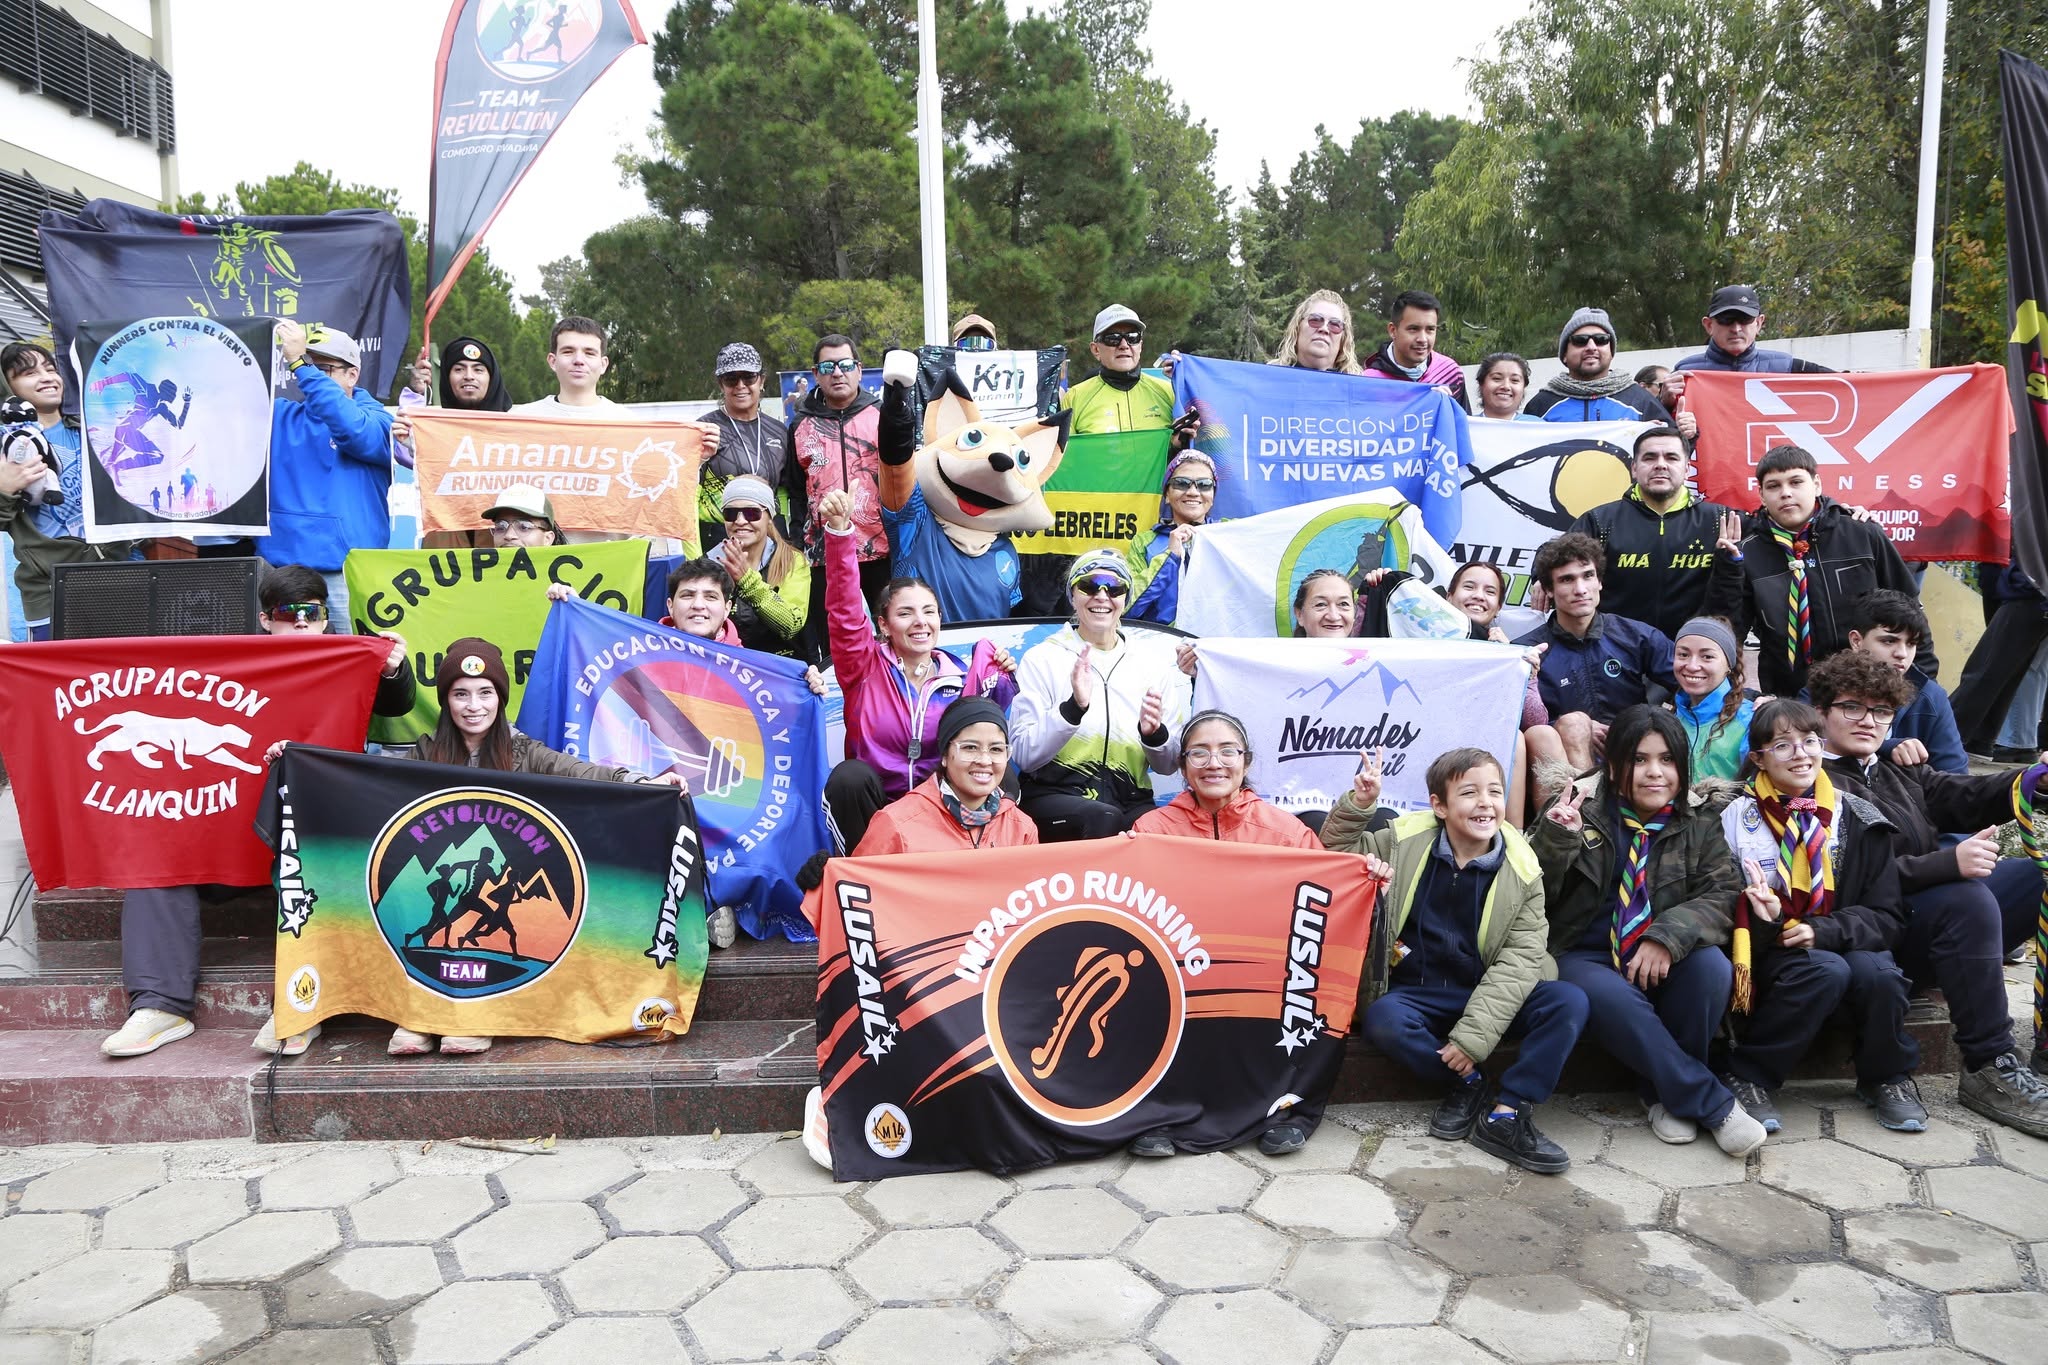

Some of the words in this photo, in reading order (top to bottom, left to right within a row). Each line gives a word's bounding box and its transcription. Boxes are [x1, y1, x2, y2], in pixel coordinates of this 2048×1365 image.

[479, 90, 541, 108] TEAM
[441, 145, 494, 158] COMODORO
[99, 325, 147, 366] RUNNERS
[149, 319, 200, 332] CONTRA
[203, 325, 216, 337] EL
[217, 331, 253, 367] VIENTO
[1261, 416, 1396, 436] DIRECCIÓN
[1403, 409, 1434, 433] DE
[450, 435, 618, 470] Amanus
[1260, 436, 1416, 458] DIVERSIDAD
[451, 474, 545, 492] RUNNING
[548, 475, 600, 492] CLUB
[1258, 463, 1276, 482] Y
[1283, 462, 1387, 483] NUEVAS
[1747, 473, 1957, 492] FNESS
[1447, 543, 1537, 568] ATLE
[355, 547, 628, 636] AGRUPACIO
[54, 667, 271, 721] AGRUPACION
[772, 728, 791, 744] Y
[1278, 712, 1422, 752] Nómades
[83, 776, 238, 821] LLANQUIN
[736, 755, 792, 853] DEPORTE
[408, 804, 552, 856] REVOLUCION
[657, 824, 698, 944] LUSAIL
[954, 872, 1075, 984] IMPACTO
[1083, 870, 1211, 977] RUNNING
[441, 962, 487, 979] TEAM
[838, 883, 890, 1038] LUSAIL
[1282, 884, 1330, 1031] LUSAIL
